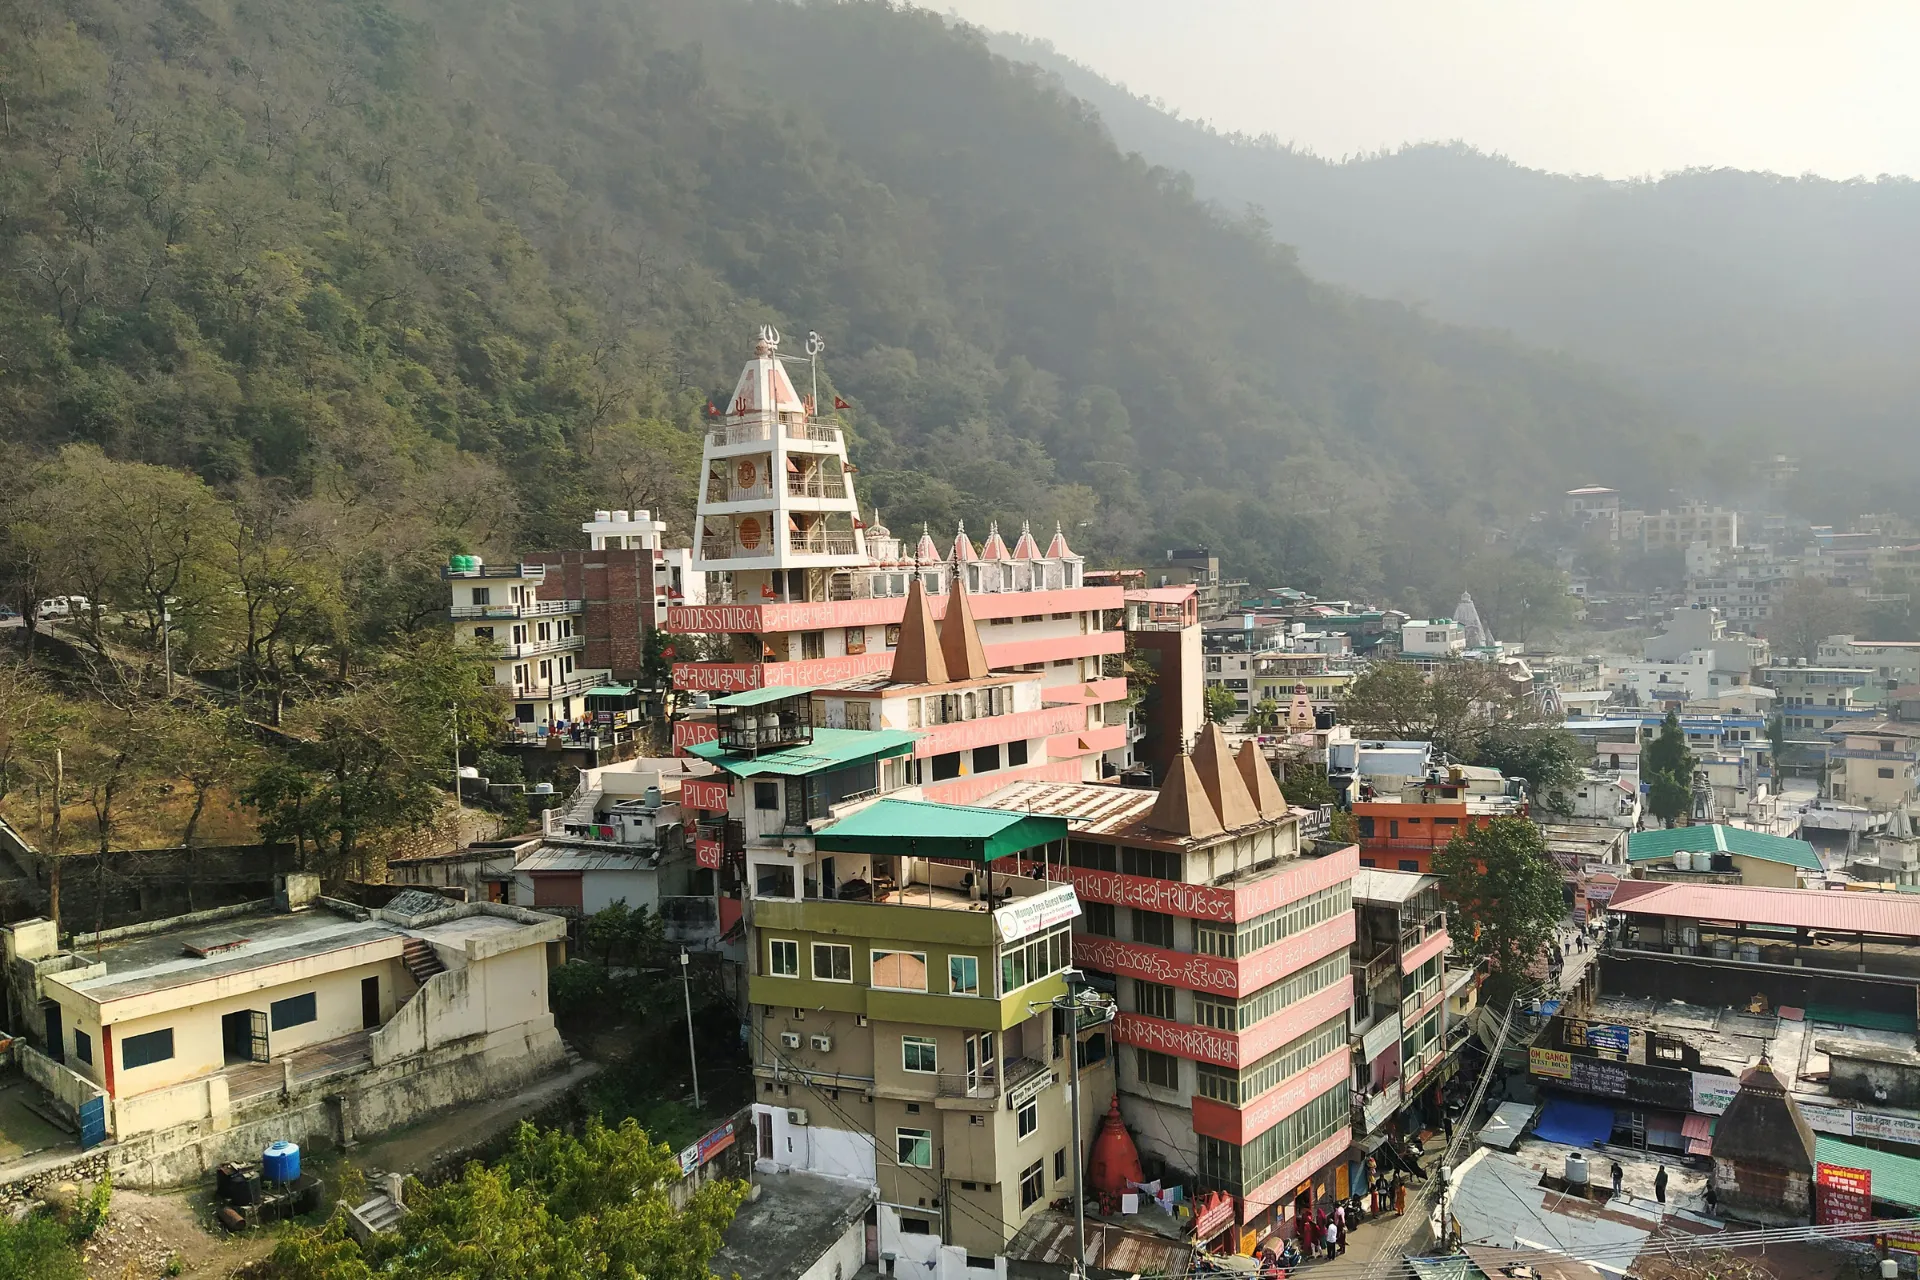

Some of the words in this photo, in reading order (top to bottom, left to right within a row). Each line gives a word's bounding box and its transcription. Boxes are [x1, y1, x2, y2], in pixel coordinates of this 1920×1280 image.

[669, 608, 721, 630] GODDESS
[722, 607, 762, 630] DURGA
[673, 665, 699, 688] दर्शन
[700, 668, 720, 689] राधा
[720, 668, 746, 690] कृष्ण
[746, 664, 761, 689] जी
[765, 664, 793, 685] दर्शन
[853, 654, 893, 677] DARSHA
[675, 724, 718, 747] DARS
[683, 784, 729, 810] PILGRI
[699, 843, 721, 867] दर्श
[1238, 888, 1268, 918] YOGA
[1272, 865, 1321, 905] TRAINING
[1530, 1058, 1549, 1066] GUEST
[1551, 1061, 1569, 1070] HOUSE
[1531, 1049, 1541, 1059] OM
[1545, 1051, 1569, 1063] GANGA
